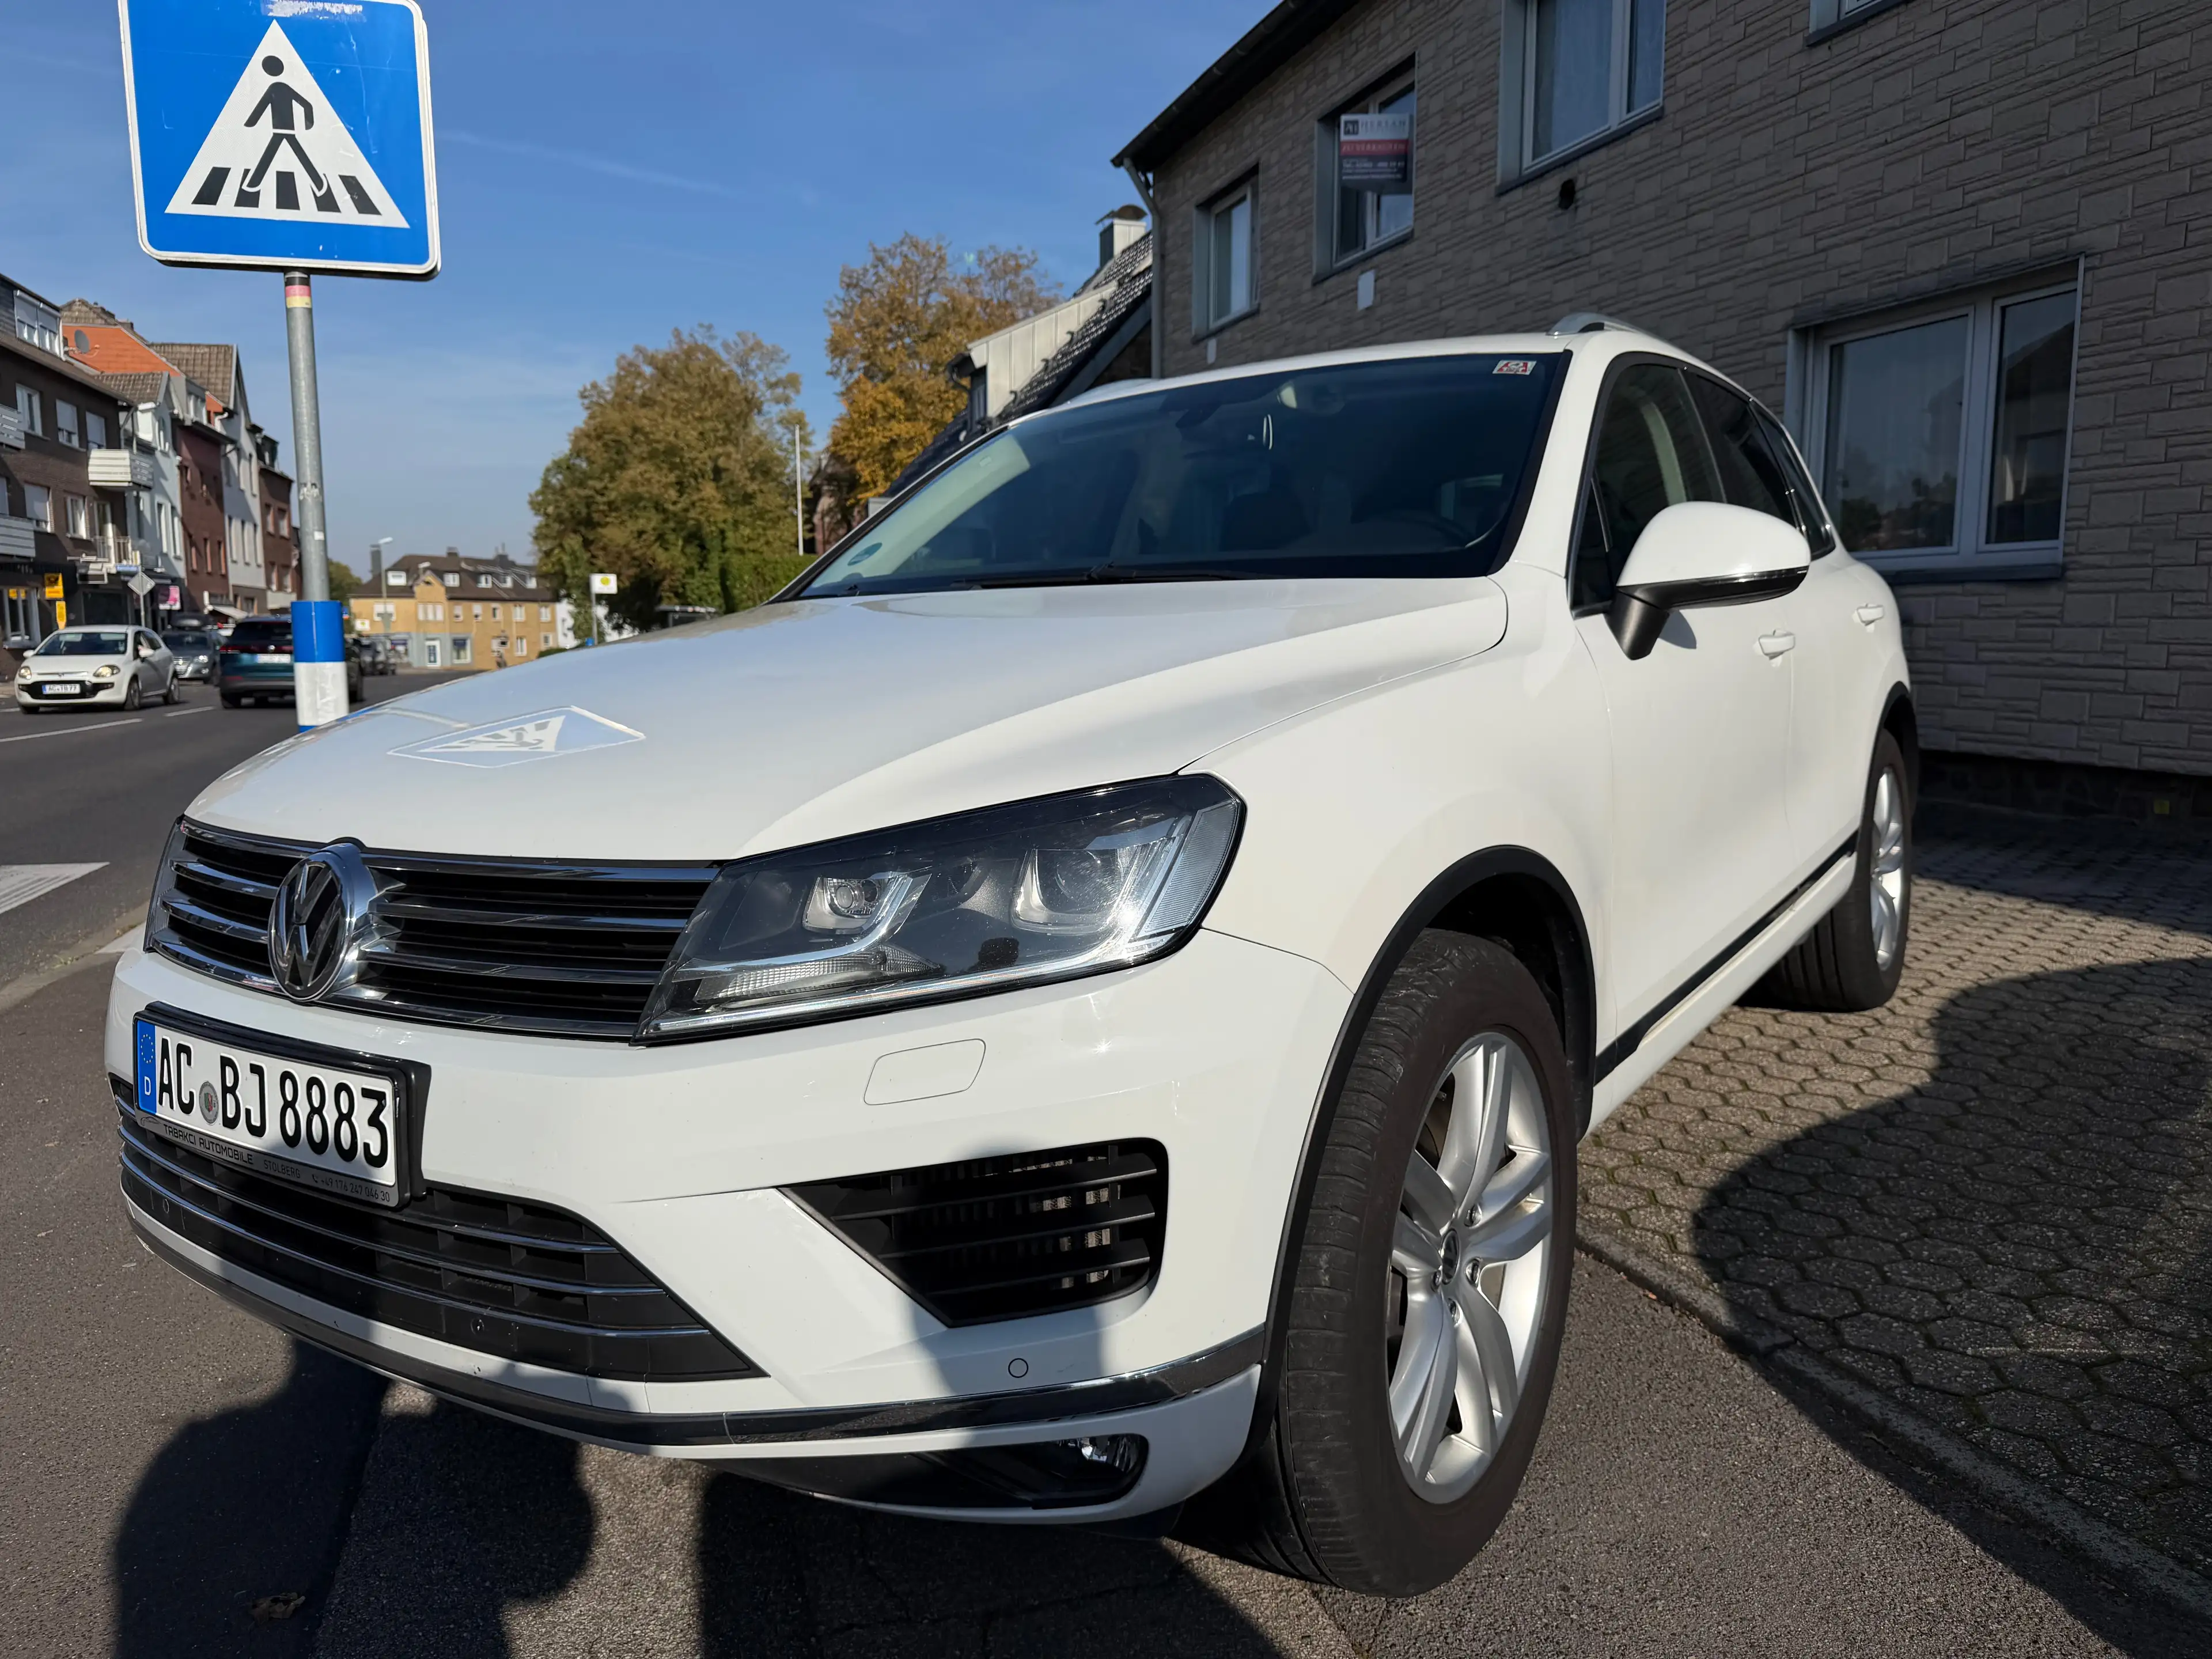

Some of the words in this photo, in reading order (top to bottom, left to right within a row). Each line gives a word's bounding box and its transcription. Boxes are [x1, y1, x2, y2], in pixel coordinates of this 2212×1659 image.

[144, 1075, 151, 1096] D
[158, 1035, 195, 1115] AC
[219, 1054, 267, 1139] BJ
[279, 1070, 388, 1168] 8883
[163, 1124, 196, 1146] TABAKCI
[199, 1137, 254, 1165] AUTOMOBILE
[264, 1159, 301, 1179] STOLBERG
[350, 1183, 363, 1195] 247
[365, 1187, 378, 1199] 046
[380, 1191, 390, 1202] 30
